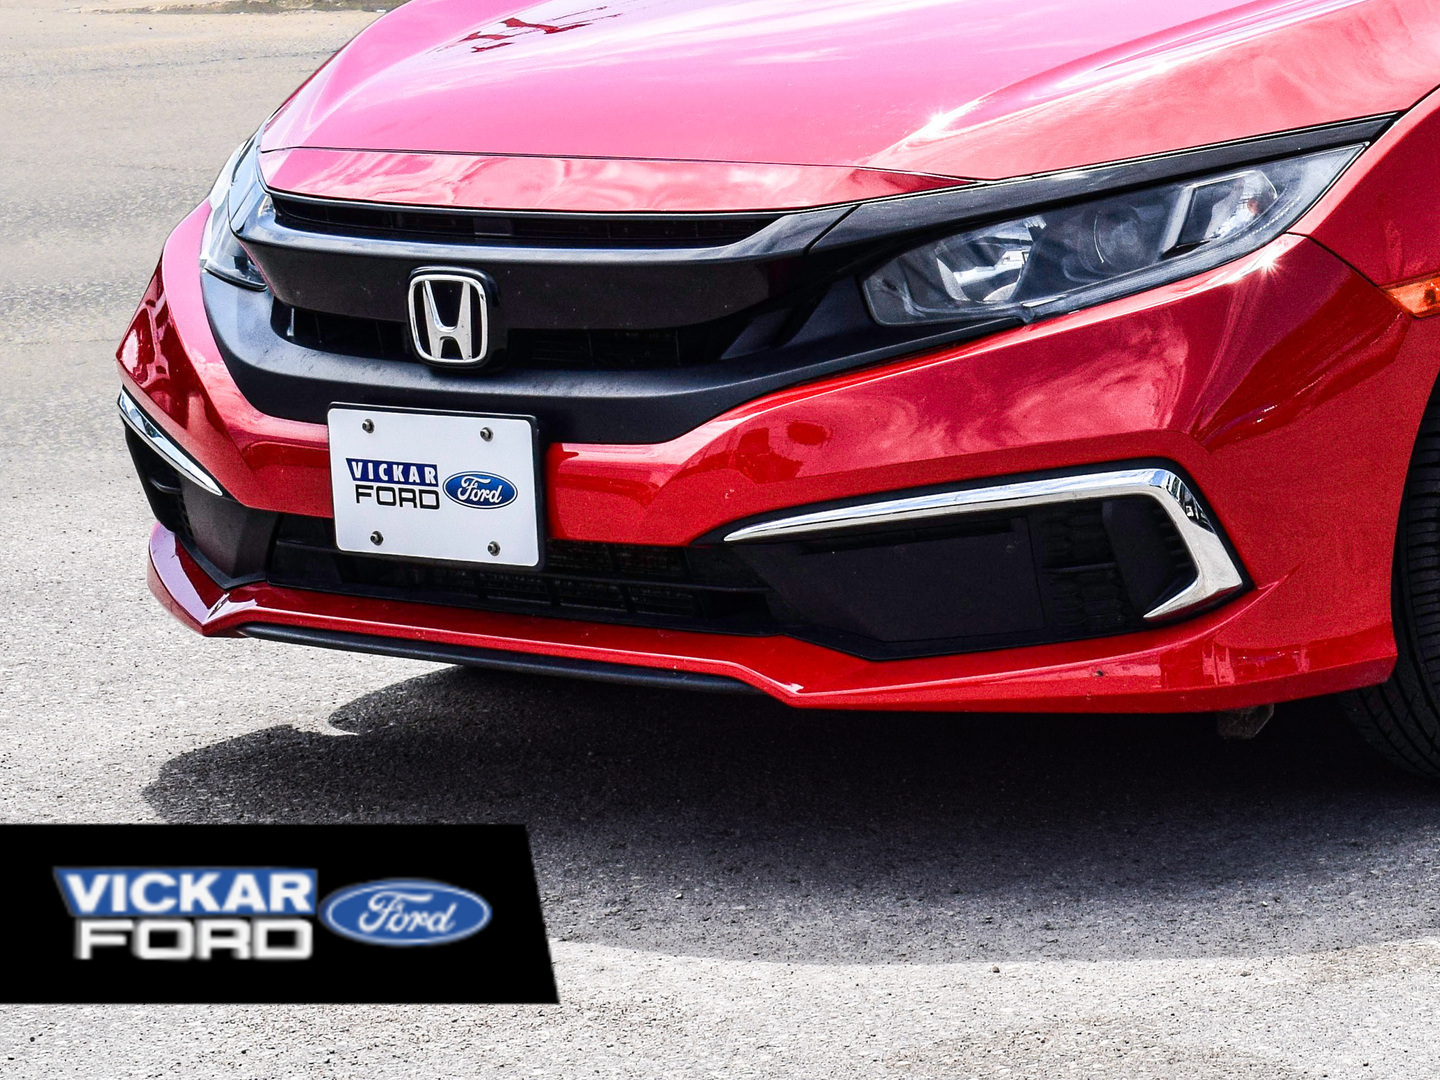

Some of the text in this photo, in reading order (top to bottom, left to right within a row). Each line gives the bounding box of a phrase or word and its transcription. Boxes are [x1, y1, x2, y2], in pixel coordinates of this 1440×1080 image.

[351, 460, 437, 485] VICKAR
[355, 475, 503, 510] FORD Ford
